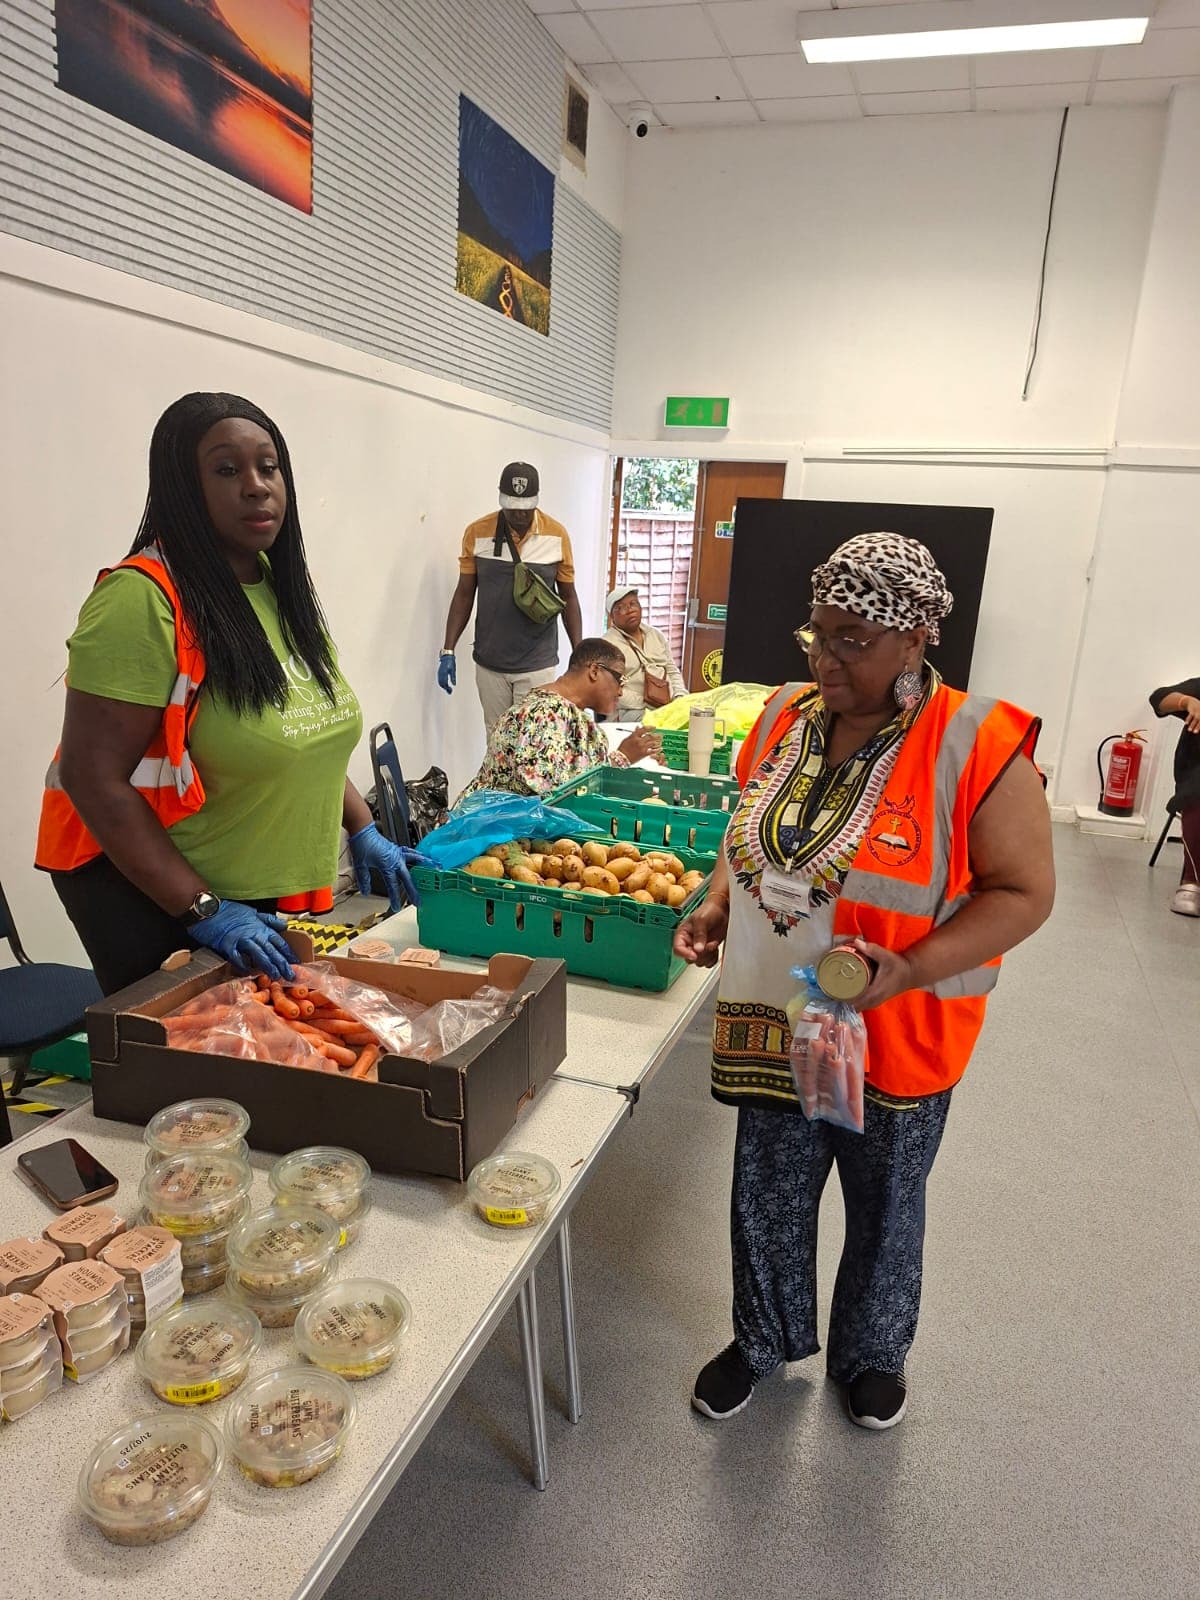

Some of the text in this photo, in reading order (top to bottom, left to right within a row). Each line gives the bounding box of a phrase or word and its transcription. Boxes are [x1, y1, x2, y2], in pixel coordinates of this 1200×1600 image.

[278, 704, 315, 720] writing
[282, 724, 299, 739] Stop
[300, 721, 321, 737] trying
[63, 1214, 97, 1235] STACKERS
[126, 1235, 160, 1260] STACKERS
[132, 1240, 166, 1264] HOUMOUS
[68, 1271, 99, 1292] STACKERS
[79, 1266, 107, 1287] HOUMOUS
[290, 1389, 302, 1438] BUTTERBEANS
[302, 1400, 313, 1421] GIANT
[119, 1431, 152, 1457] 21/07/25
[125, 1442, 189, 1490] BUTTERBEANS
[151, 1462, 180, 1484] GIANT
